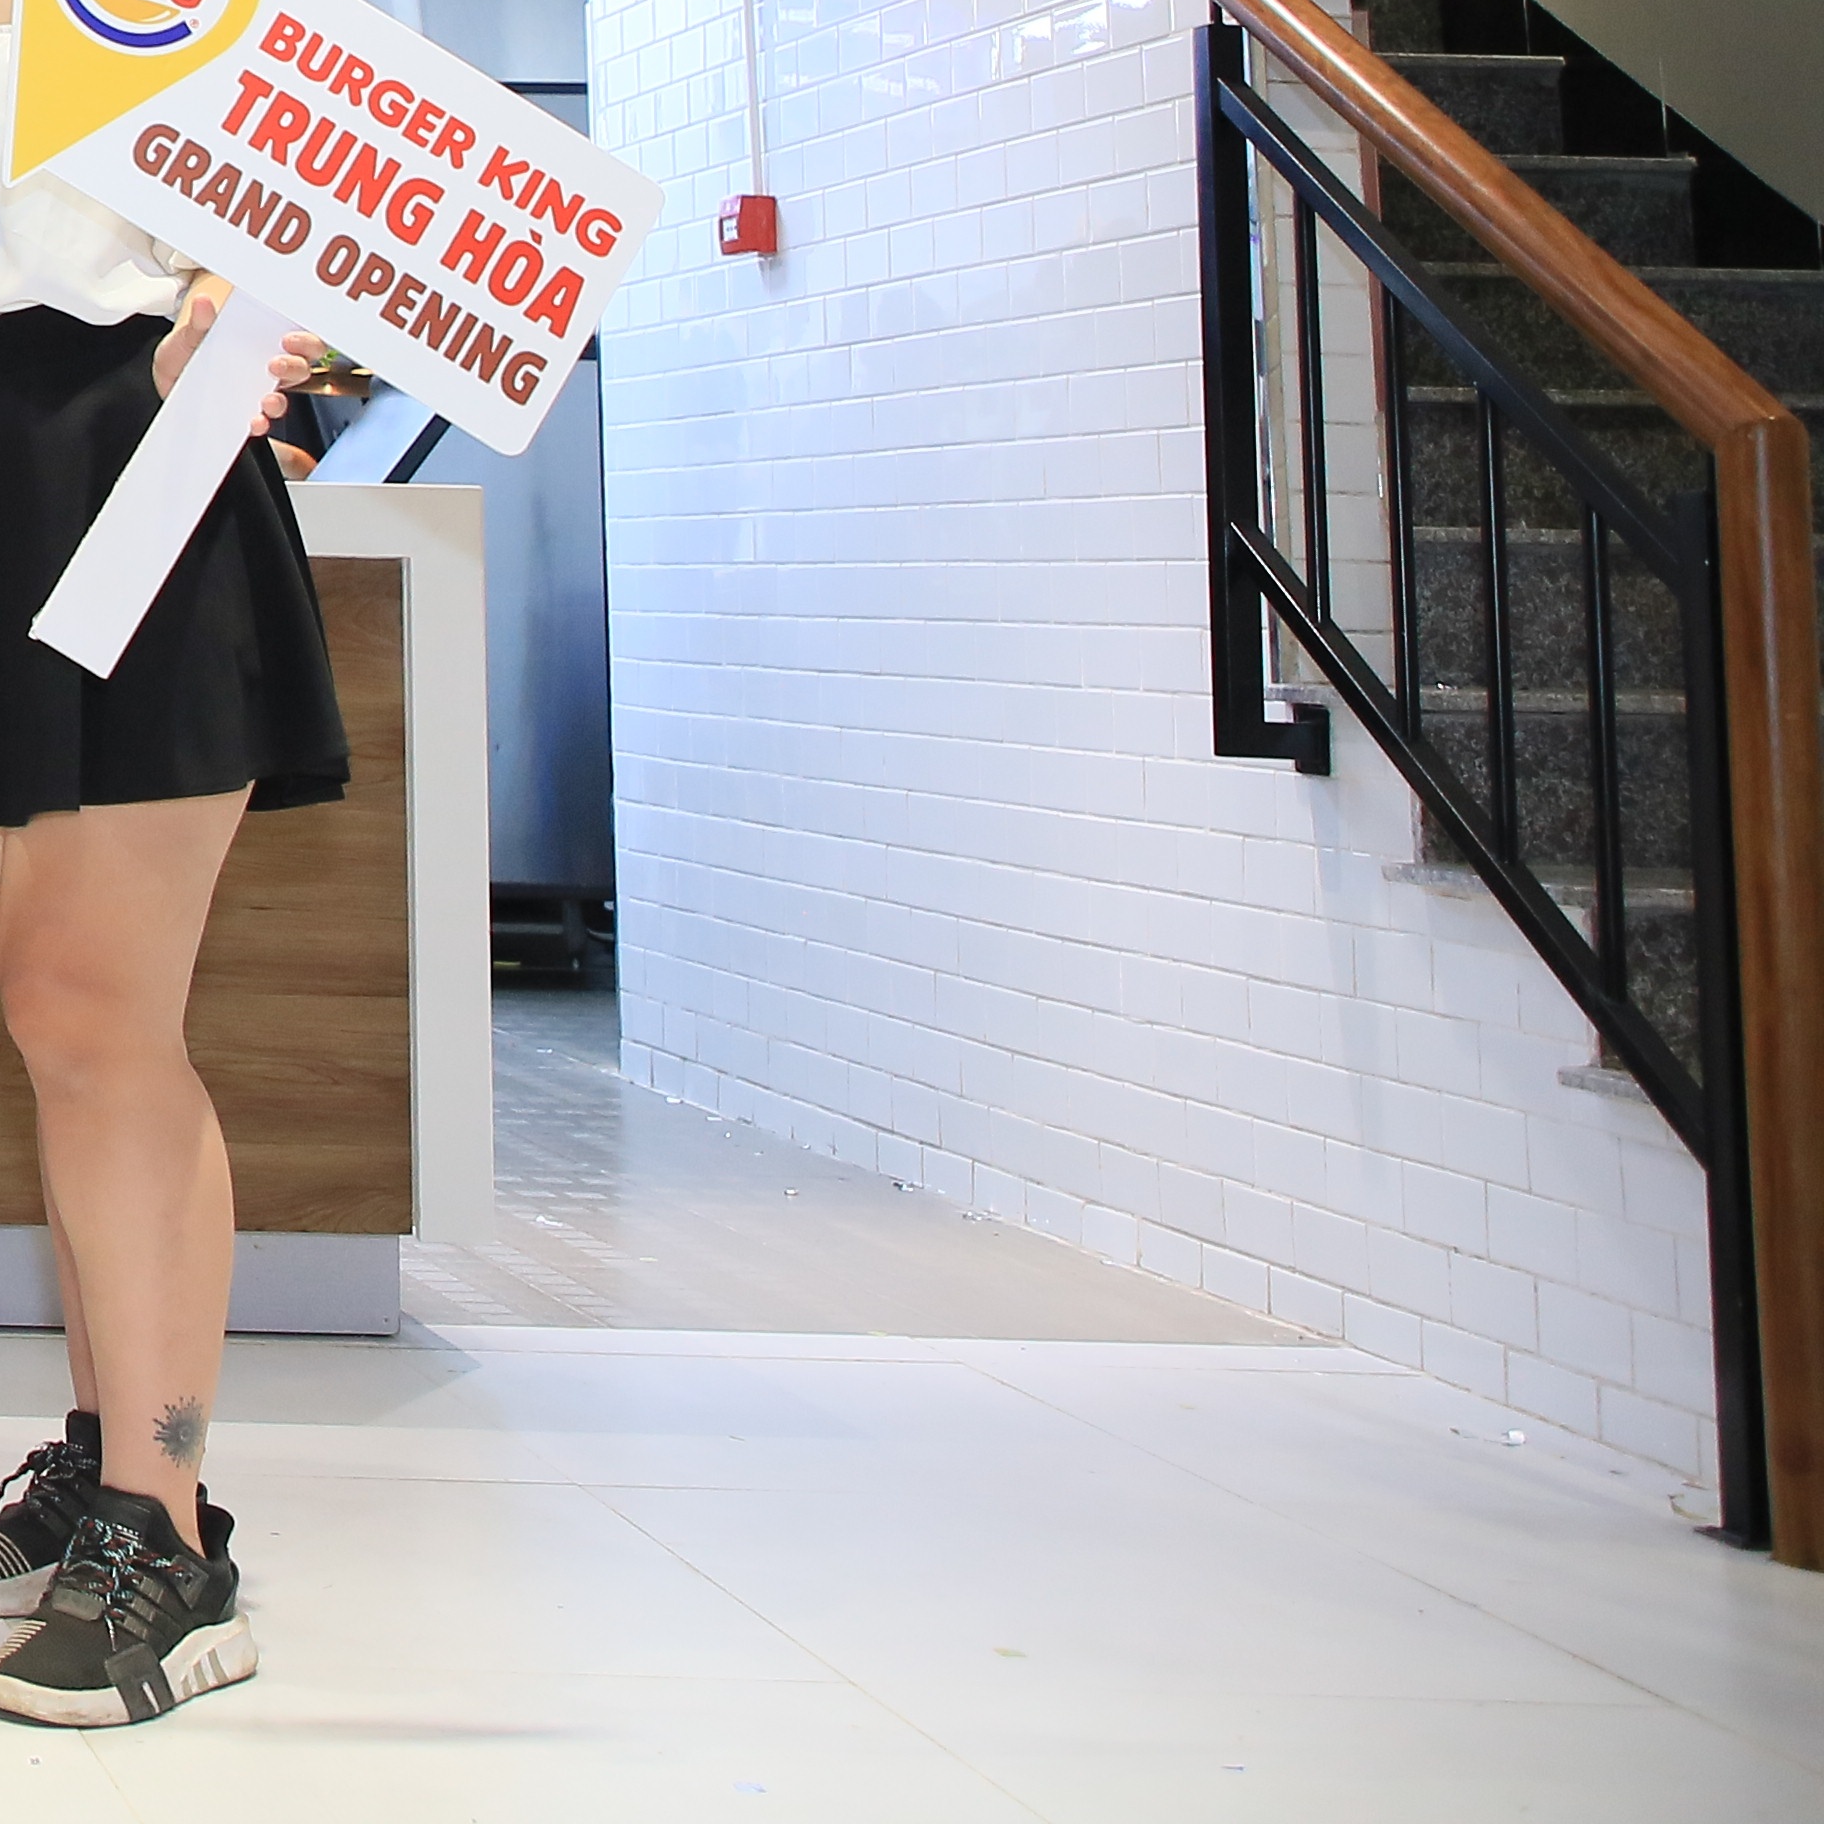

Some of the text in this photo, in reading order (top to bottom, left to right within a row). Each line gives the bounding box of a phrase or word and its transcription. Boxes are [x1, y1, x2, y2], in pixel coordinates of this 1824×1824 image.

[132, 122, 549, 407] GRAND OPENING
[220, 69, 586, 339] TRUNG HÒA
[259, 12, 624, 259] BURGER KING
